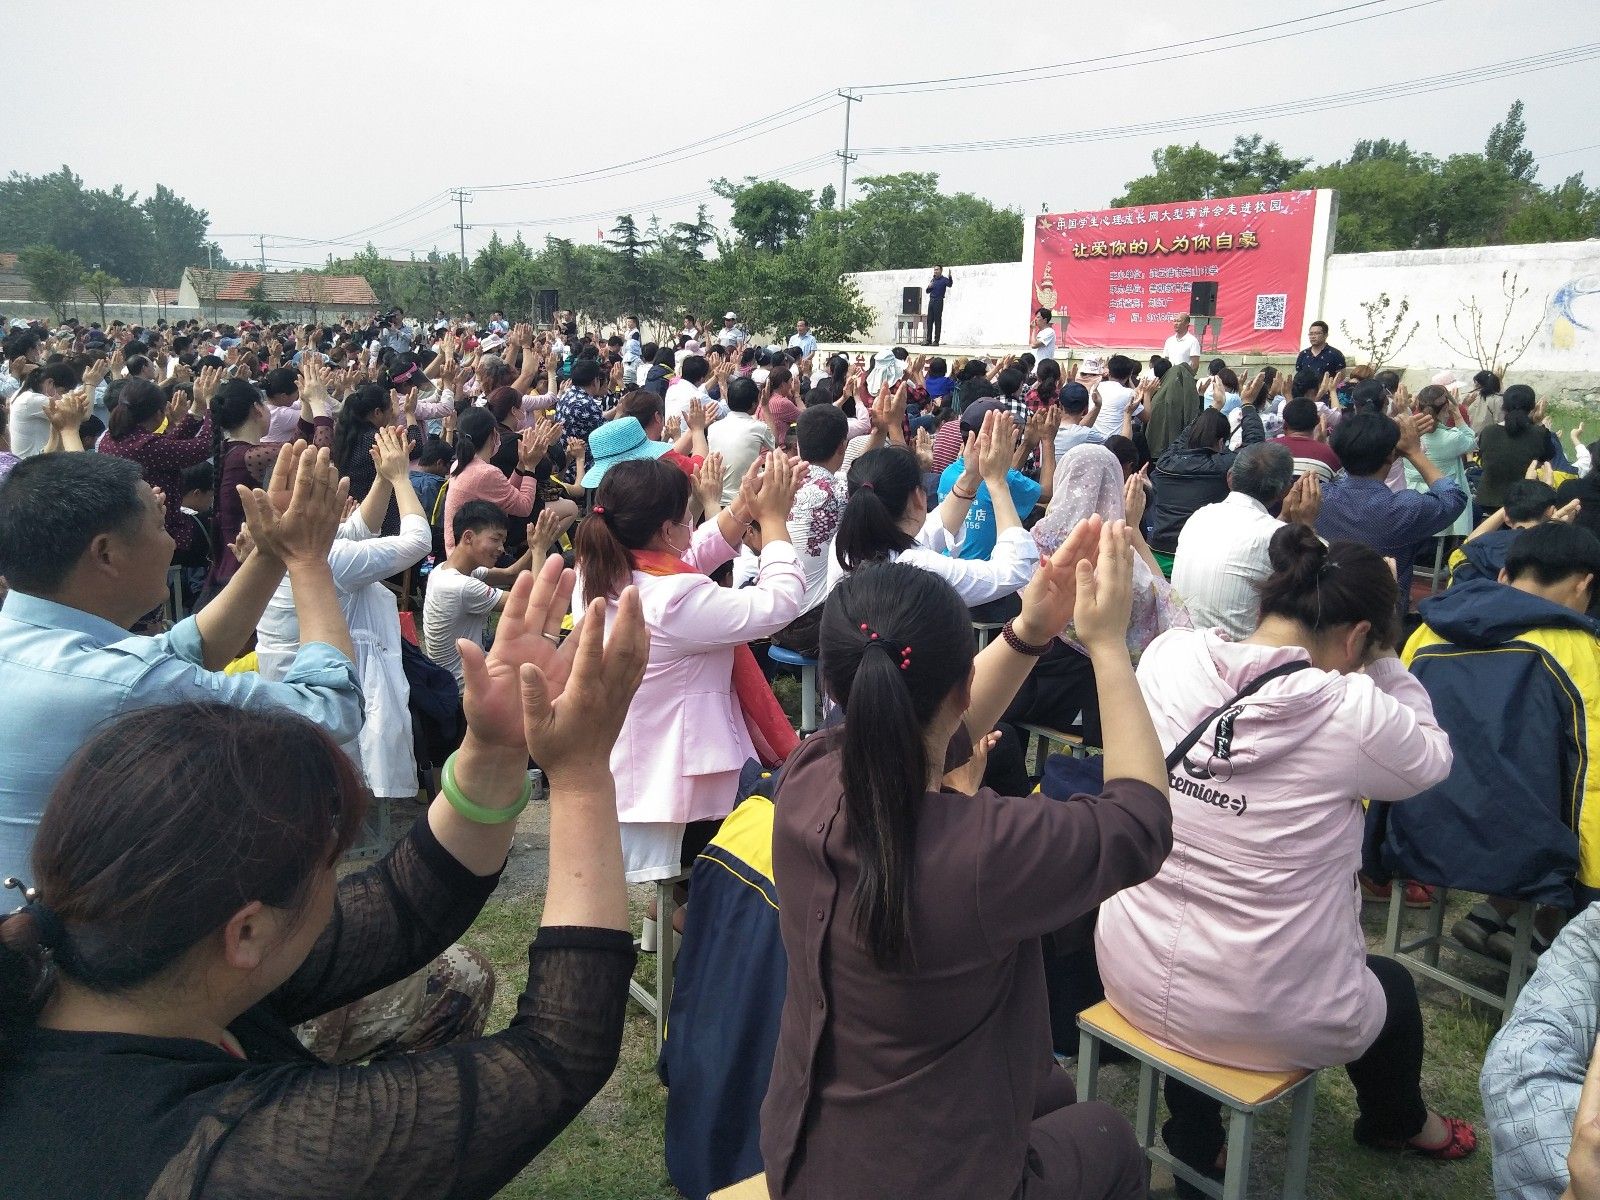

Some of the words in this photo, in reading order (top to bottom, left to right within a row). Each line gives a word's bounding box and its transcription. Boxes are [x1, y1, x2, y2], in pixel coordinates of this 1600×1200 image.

[1056, 199, 1282, 230] 中国学生心理成长网大型演讲会走进校园
[1072, 230, 1259, 258] 让爱你的人为你自豪
